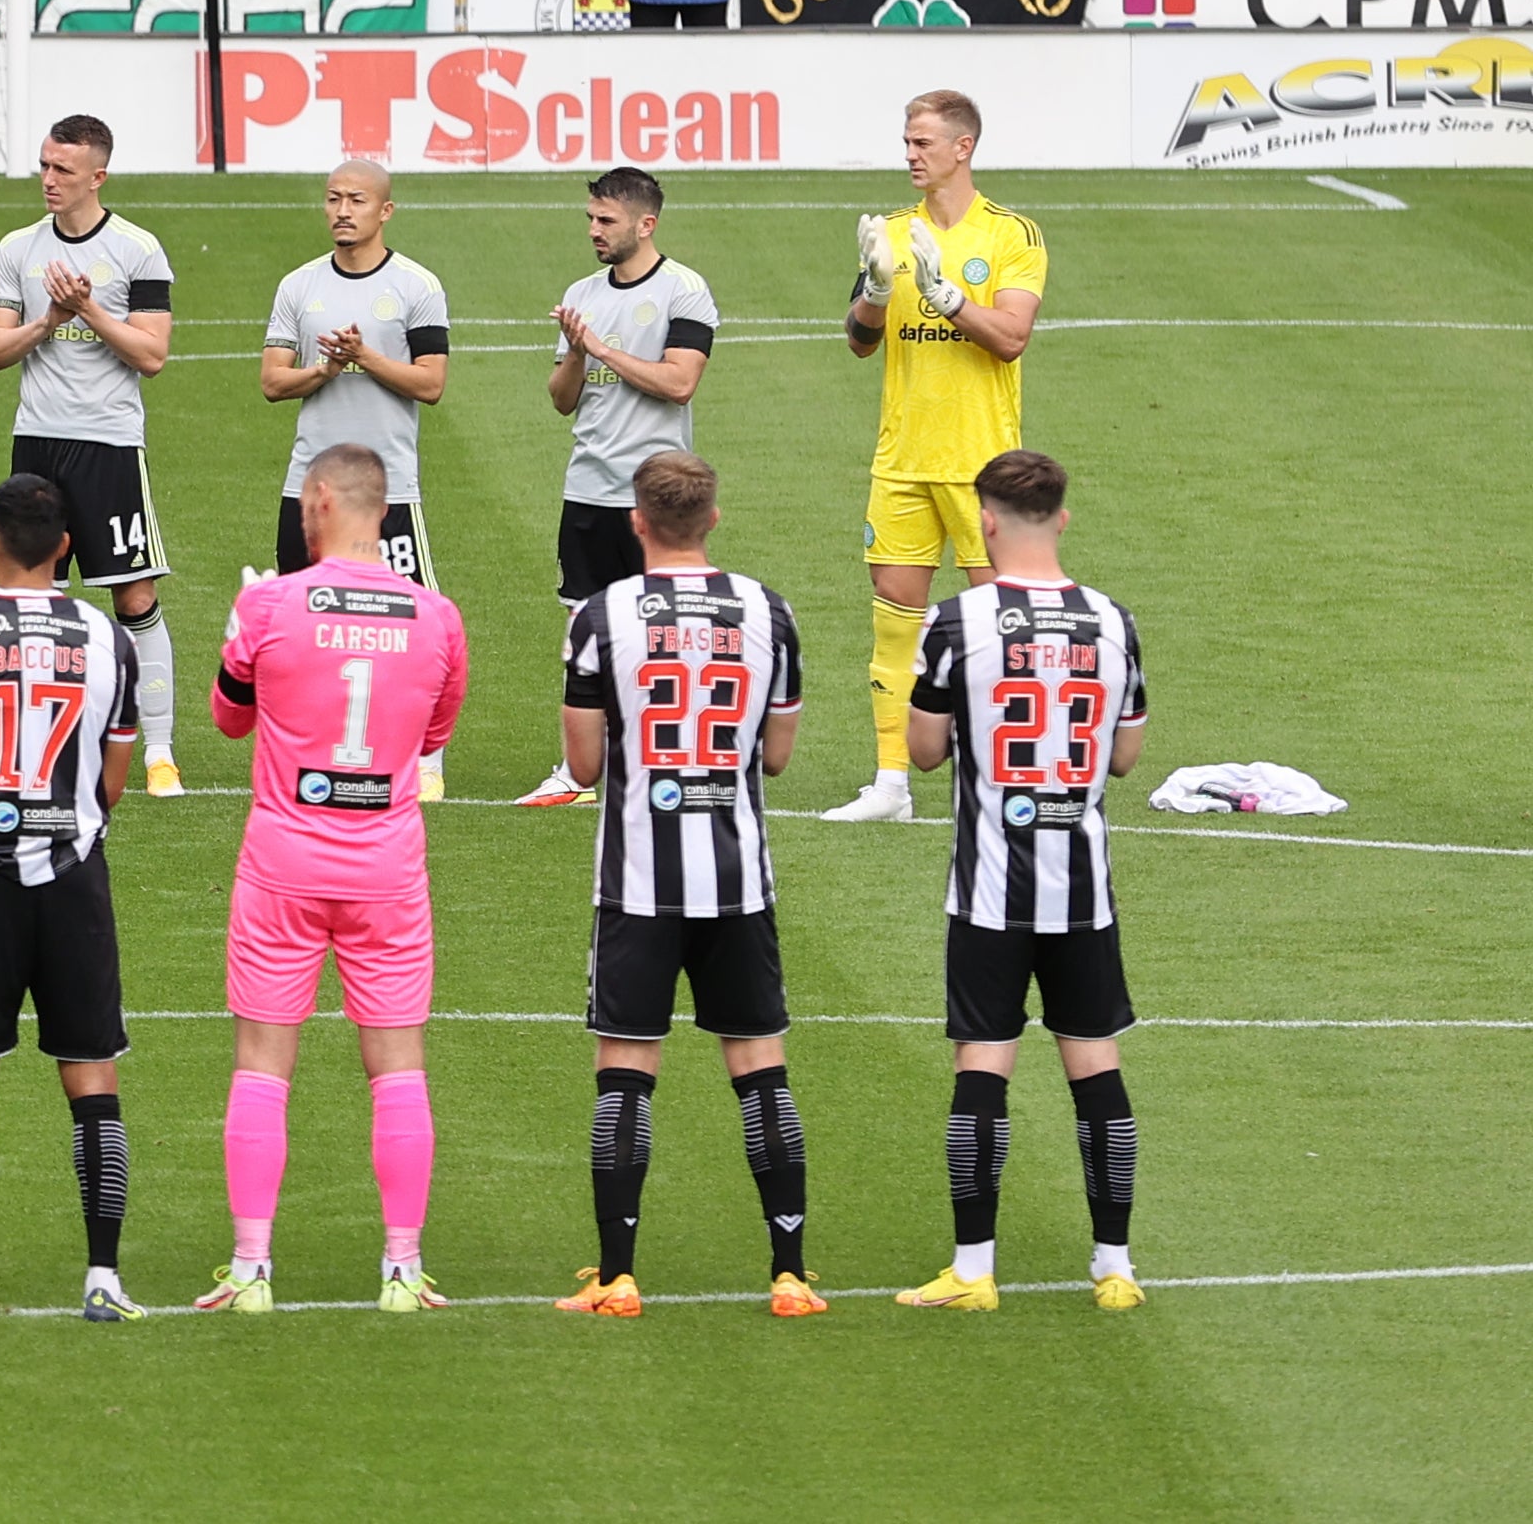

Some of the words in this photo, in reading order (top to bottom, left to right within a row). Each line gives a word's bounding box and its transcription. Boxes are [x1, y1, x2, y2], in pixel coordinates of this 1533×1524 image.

[1186, 142, 1261, 170] Serving
[1266, 126, 1335, 151] British
[1343, 116, 1430, 137] Industry
[1437, 117, 1494, 132] Since
[109, 511, 147, 556] 14
[346, 593, 374, 602] FIRST
[375, 595, 415, 606] VEHICLE
[676, 595, 703, 605] FIRST
[704, 597, 744, 608] VEHICLE
[346, 602, 389, 613] LEASING
[676, 603, 719, 614] LEASING
[1035, 610, 1062, 620] FIRST
[1063, 613, 1101, 623] VEHICLE
[19, 616, 47, 626] FIRST
[48, 619, 88, 631] VEHICLE
[19, 624, 62, 635] LEASING
[1035, 620, 1077, 630] LEASING
[315, 623, 409, 653] CARSON
[647, 625, 742, 654] FRASER
[1006, 644, 1097, 671] STRAIN
[332, 657, 374, 769] 1
[635, 659, 753, 770] 22
[990, 678, 1109, 787] 23
[334, 779, 390, 792] consilium
[685, 784, 736, 796] consilium
[22, 807, 75, 819] consilium
